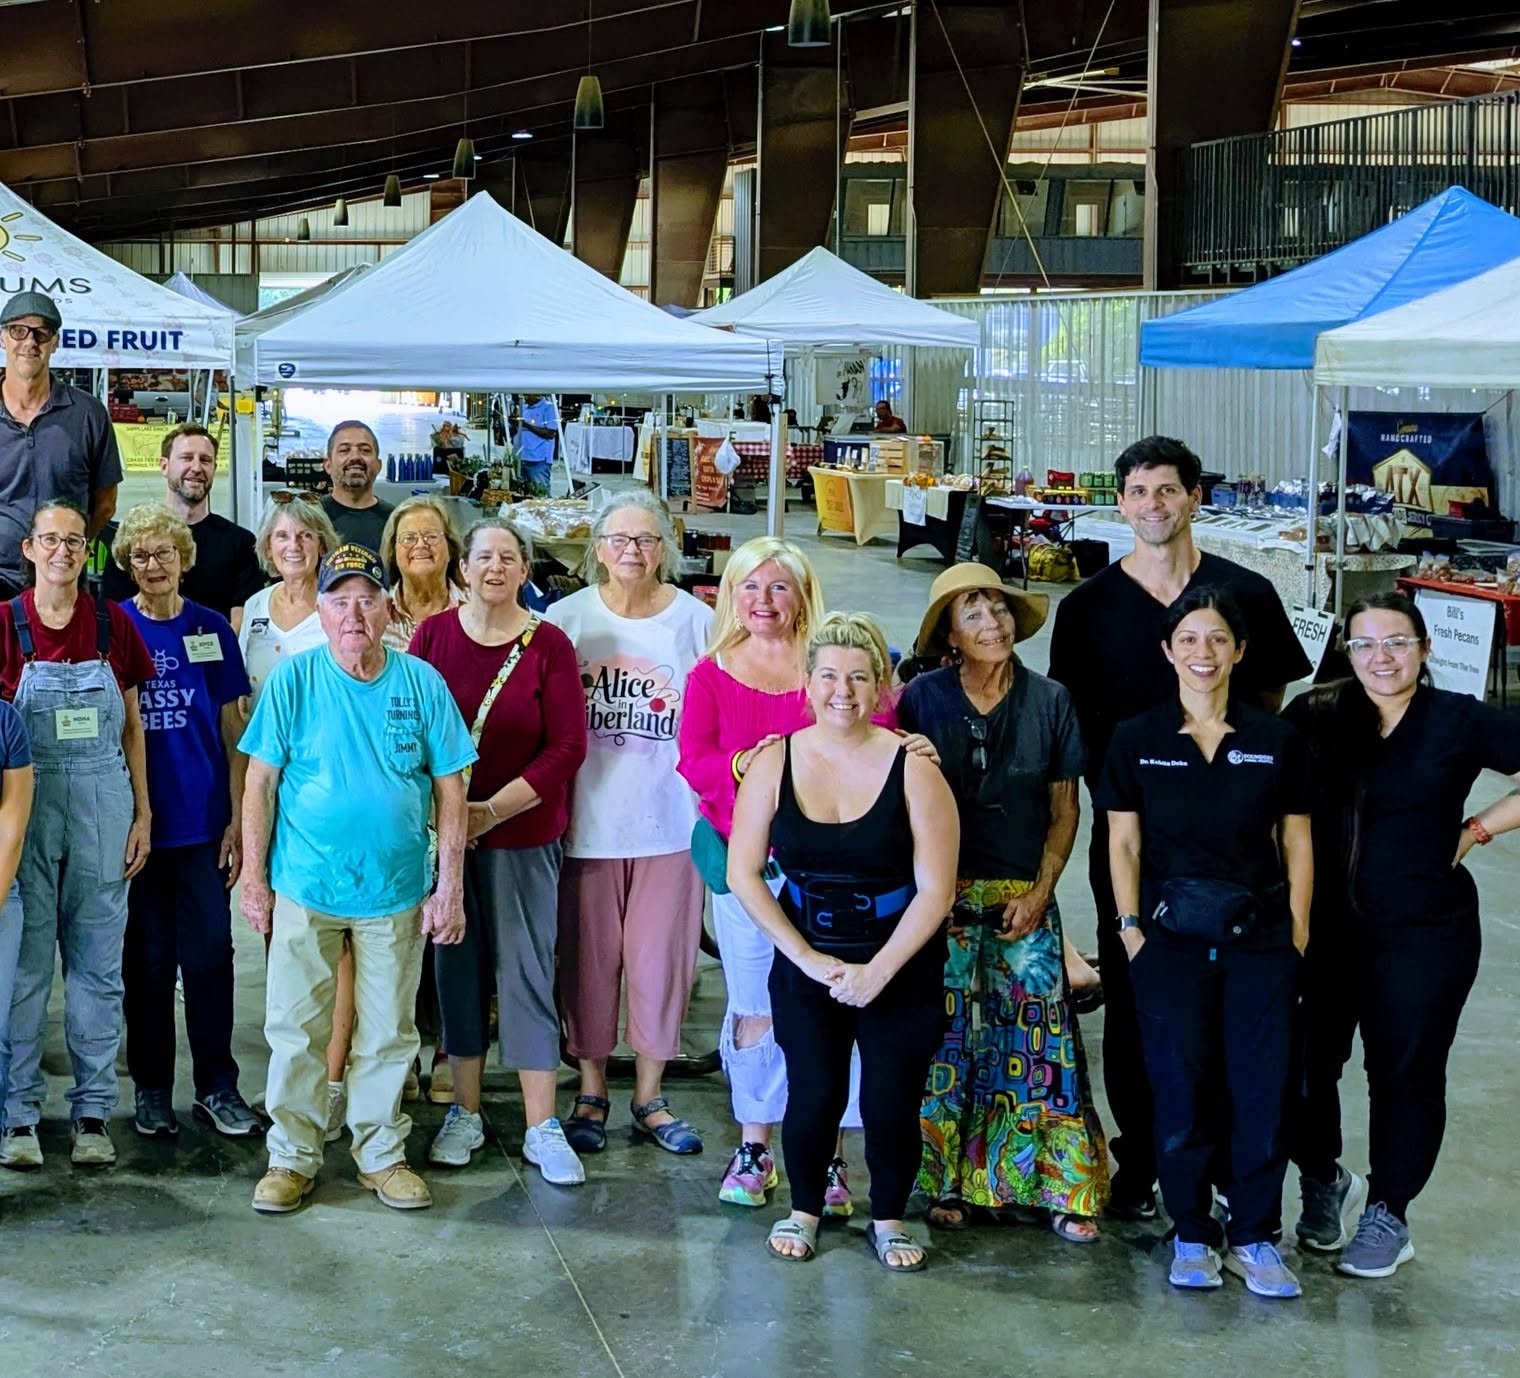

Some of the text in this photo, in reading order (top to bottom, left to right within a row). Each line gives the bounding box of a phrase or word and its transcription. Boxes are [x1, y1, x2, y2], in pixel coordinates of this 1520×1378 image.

[58, 328, 98, 349] ED
[107, 329, 184, 351] FRUIT
[1380, 433, 1433, 444] HANDCRAFTED
[1385, 465, 1422, 507] ATX
[1447, 605, 1464, 620] Bill's
[1293, 616, 1328, 643] FRESH
[1434, 624, 1479, 645] Fresh Pecans
[1459, 662, 1469, 672] The
[145, 679, 176, 689] TEXAS
[590, 664, 656, 705] Alice
[139, 688, 196, 710] ASSY
[618, 699, 627, 709] in
[585, 702, 676, 738] iberland
[395, 742, 418, 753] JIMMY
